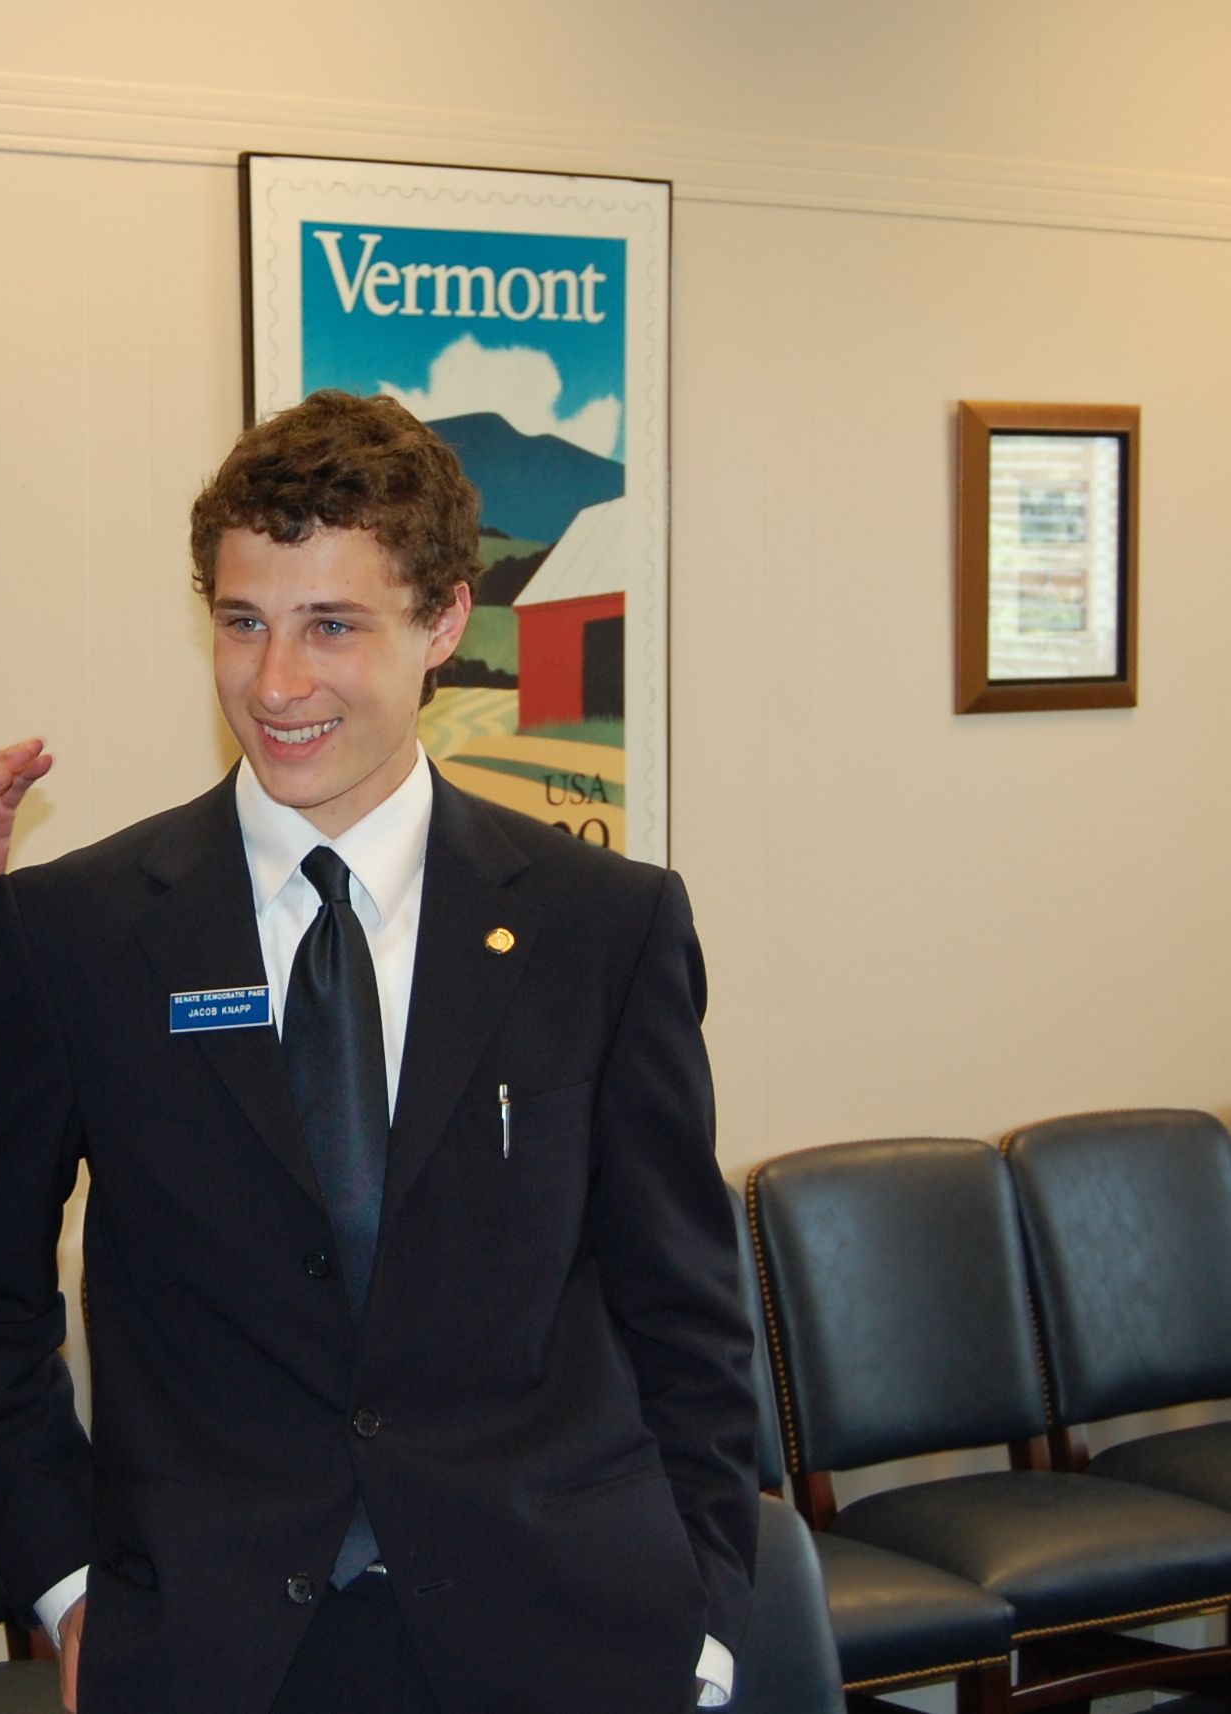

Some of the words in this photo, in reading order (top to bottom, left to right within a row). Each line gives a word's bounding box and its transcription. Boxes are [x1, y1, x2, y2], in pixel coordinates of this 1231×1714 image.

[312, 230, 607, 324] Vermont
[544, 773, 609, 806] USA
[174, 995, 200, 1004] SENATE
[203, 991, 245, 1001] DEMOCRATIC
[188, 1007, 217, 1017] JACOB
[221, 1004, 251, 1014] KNAPP
